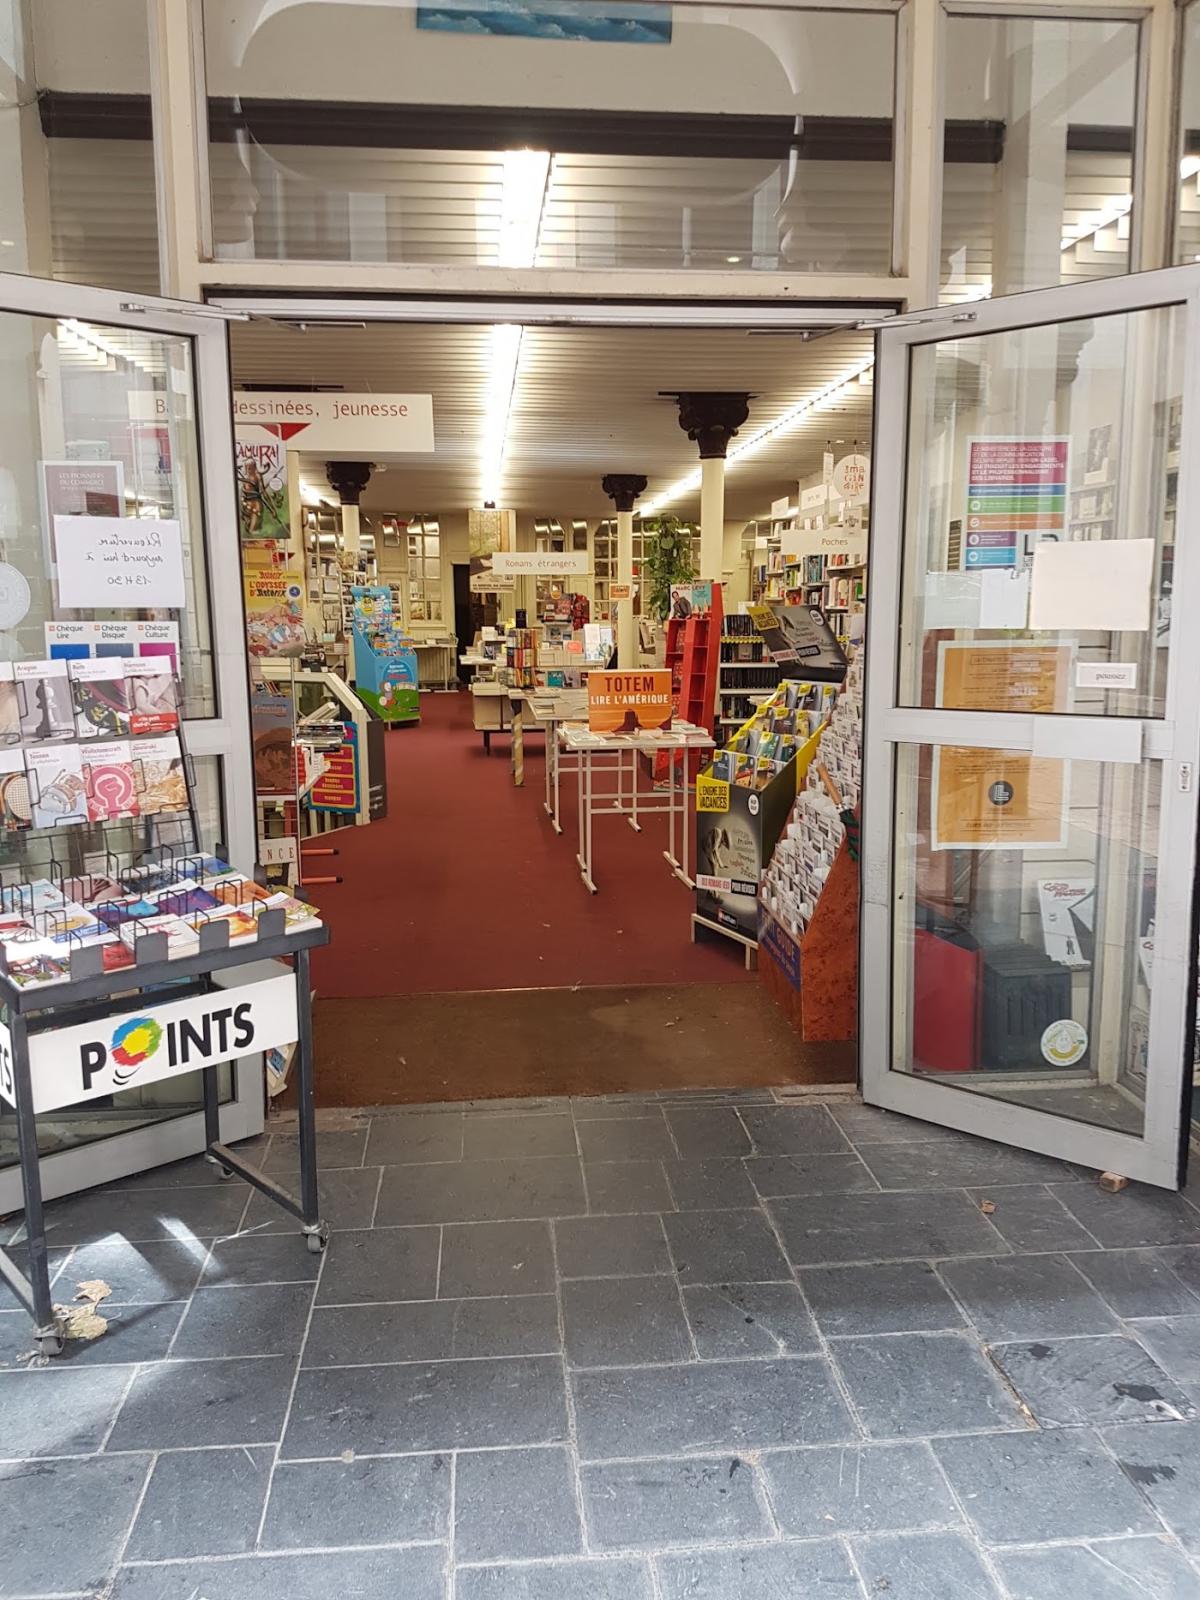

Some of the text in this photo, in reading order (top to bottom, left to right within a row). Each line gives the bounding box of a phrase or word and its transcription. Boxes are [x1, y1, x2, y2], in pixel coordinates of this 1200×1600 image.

[332, 401, 408, 419] jeunesse
[821, 538, 848, 546] Poches
[505, 558, 577, 569] Romans étrangers
[56, 624, 84, 632] Chèque
[101, 624, 128, 632] Chèque
[145, 624, 171, 632] Chèque
[101, 632, 126, 640] Disque
[604, 676, 655, 693] TOTEM
[590, 693, 669, 705] LIRE L'AMÉRIQUE
[80, 1002, 256, 1091] POINTS
